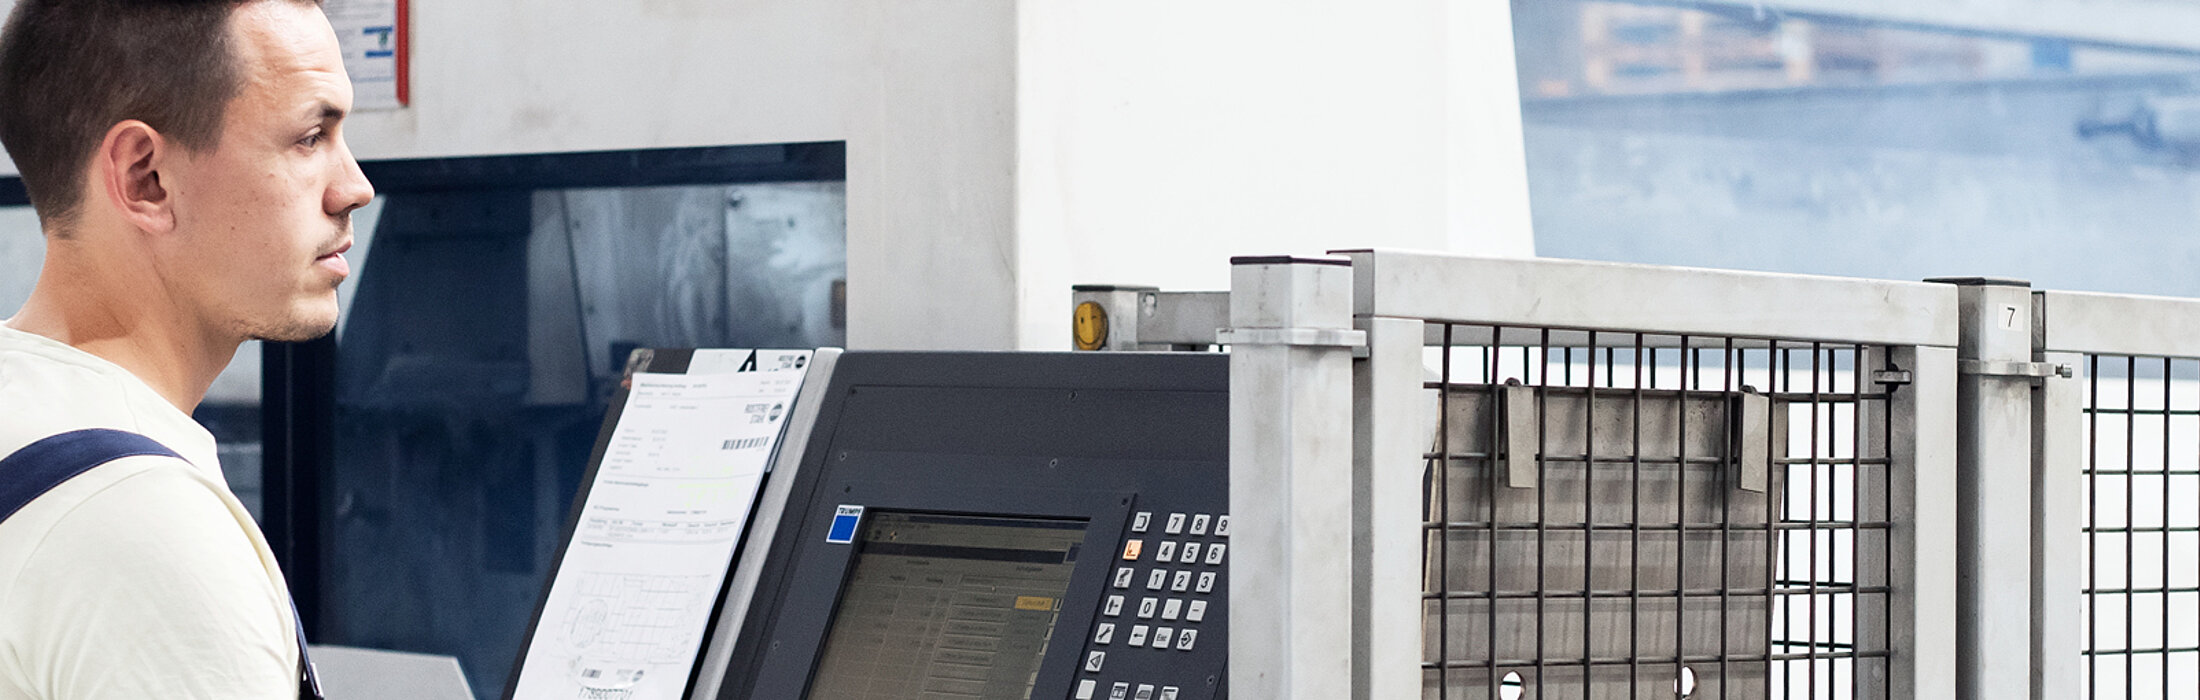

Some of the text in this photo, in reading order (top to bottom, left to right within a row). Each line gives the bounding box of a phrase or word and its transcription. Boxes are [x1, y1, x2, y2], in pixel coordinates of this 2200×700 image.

[2007, 306, 2016, 327] 7
[1196, 518, 1204, 531] 8
[1220, 519, 1228, 532] 9
[1162, 545, 1218, 560] 4 5 6
[1176, 574, 1185, 587] 2
[1201, 576, 1210, 589] 3
[1143, 602, 1151, 614] 0
